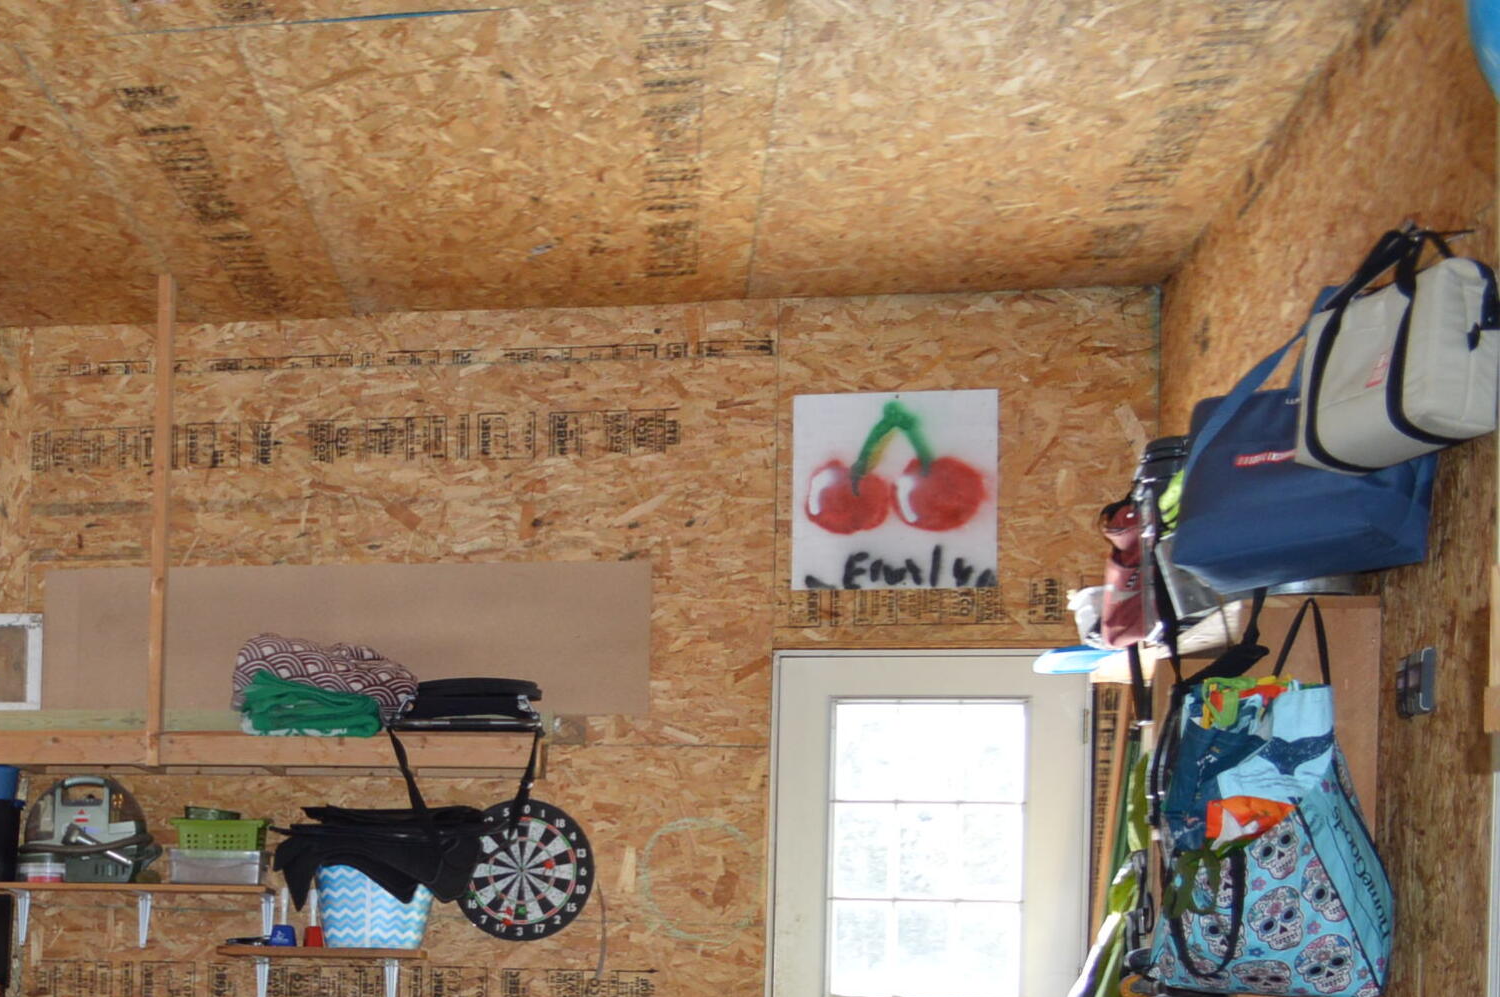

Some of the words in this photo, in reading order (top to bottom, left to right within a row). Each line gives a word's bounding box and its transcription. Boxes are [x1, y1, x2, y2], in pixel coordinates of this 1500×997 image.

[555, 818, 566, 828] 18
[1331, 805, 1392, 939] HomeGoods
[566, 902, 577, 912] 15
